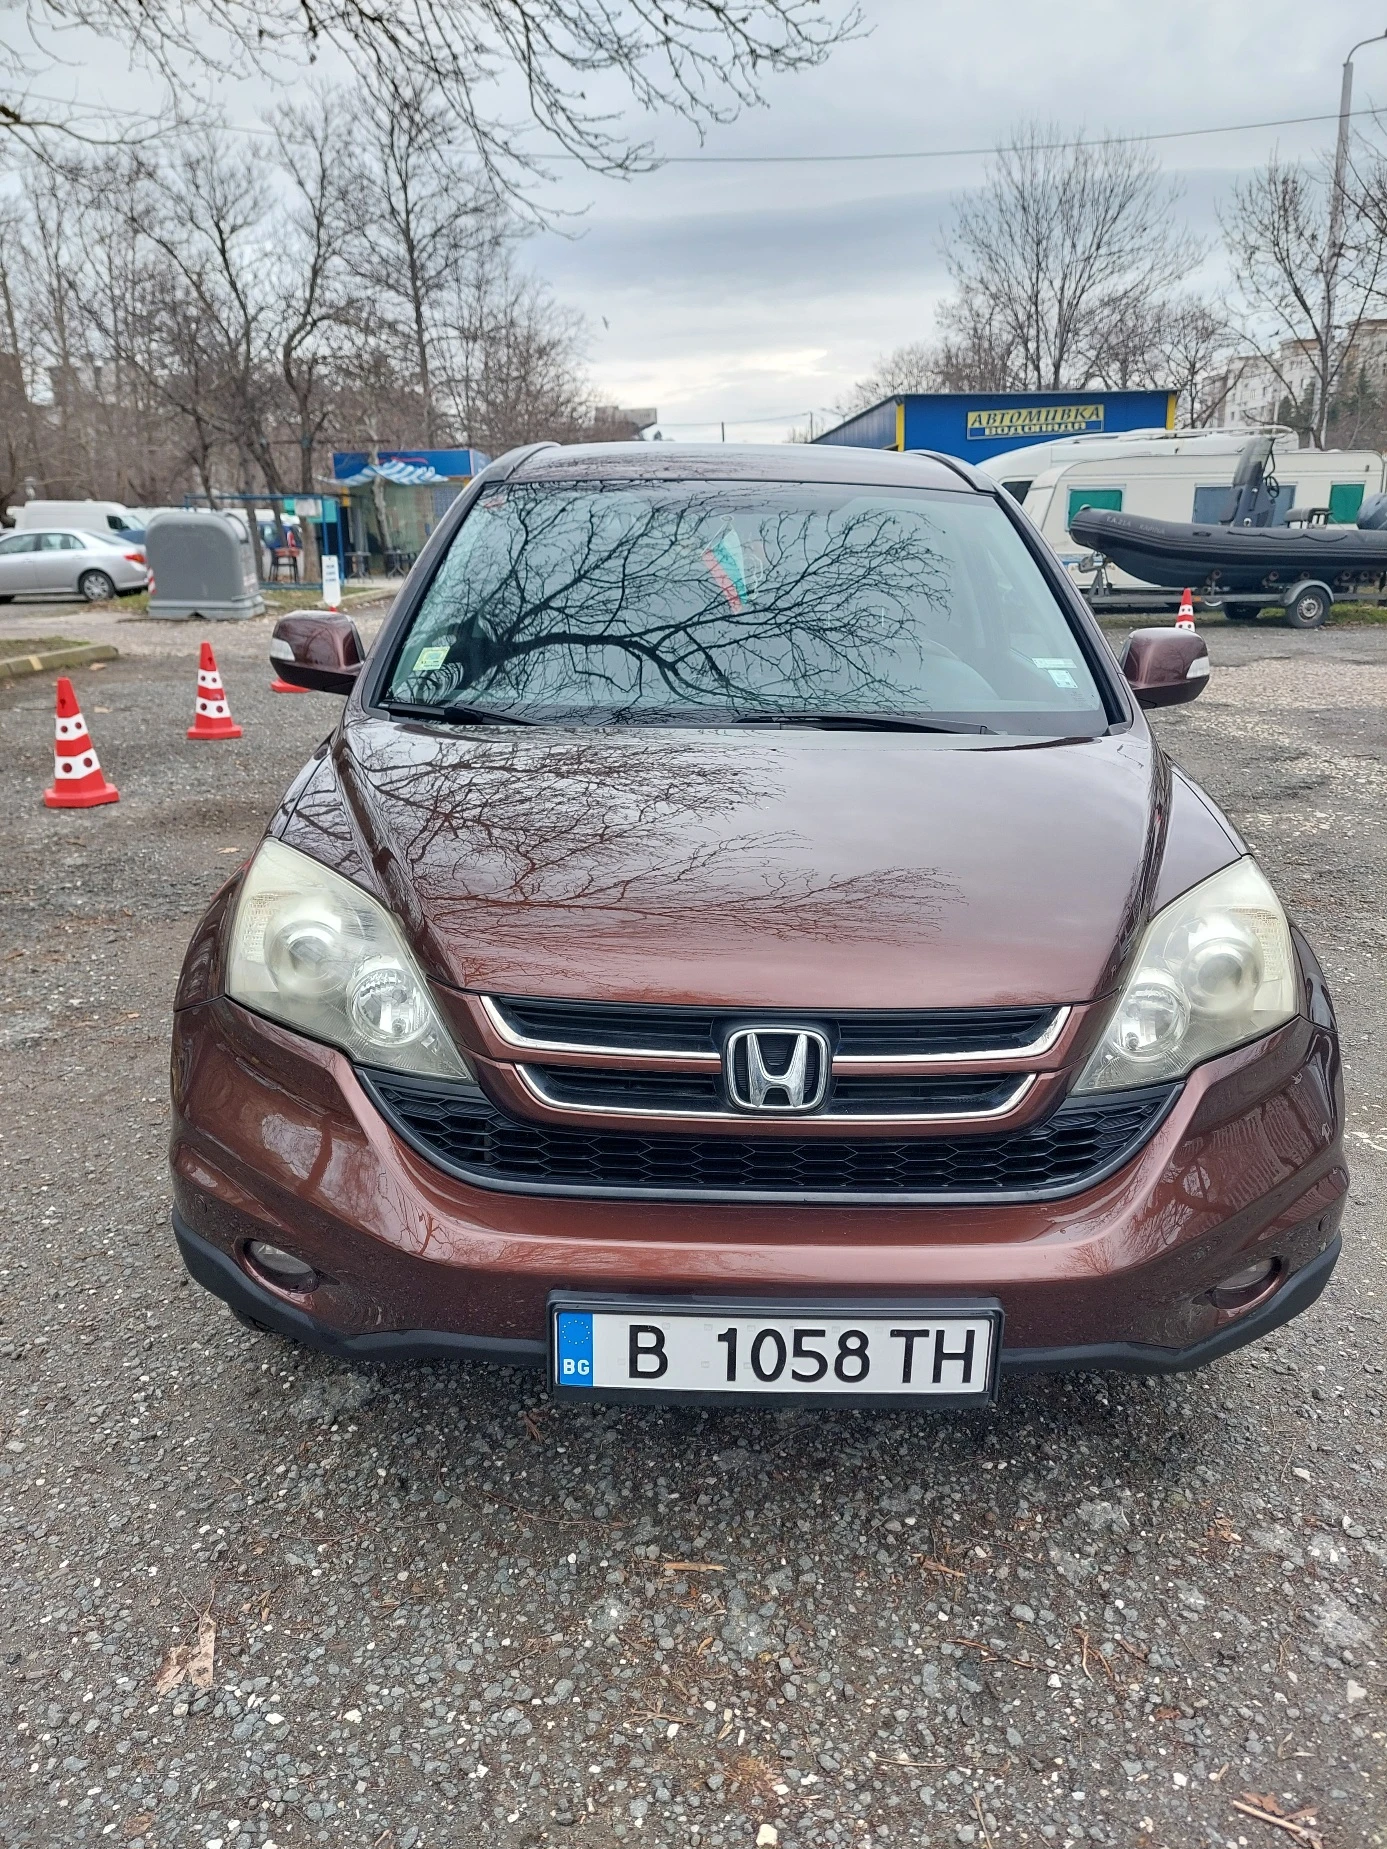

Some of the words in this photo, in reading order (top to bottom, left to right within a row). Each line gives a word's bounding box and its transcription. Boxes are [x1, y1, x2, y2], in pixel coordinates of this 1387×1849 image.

[970, 406, 1100, 427] АВТОМИВКА
[629, 1325, 669, 1379] B
[717, 1327, 871, 1383] 1058
[890, 1329, 977, 1384] TH
[563, 1359, 590, 1375] BG
